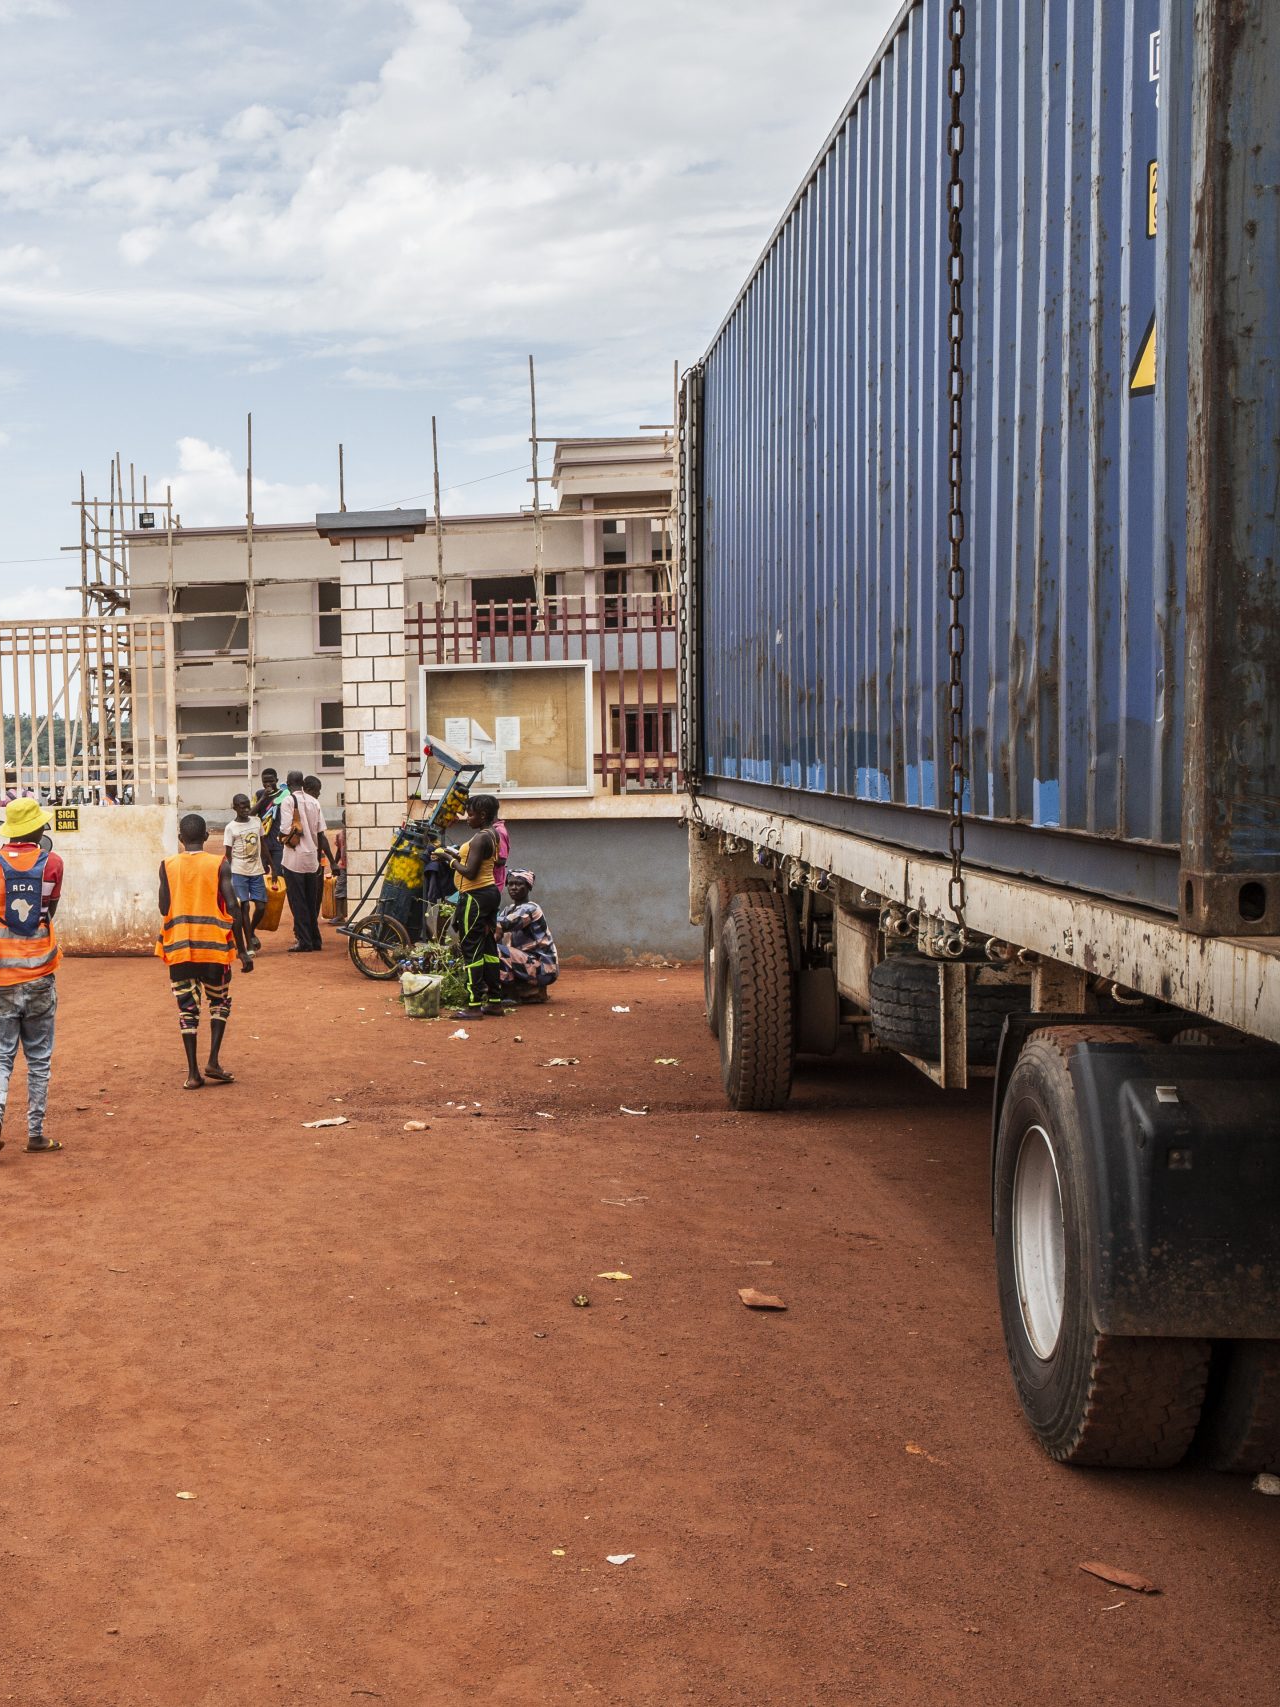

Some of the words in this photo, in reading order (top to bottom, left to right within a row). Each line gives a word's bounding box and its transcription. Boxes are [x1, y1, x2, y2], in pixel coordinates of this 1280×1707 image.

[57, 810, 76, 819] SICA
[57, 821, 76, 830] SARL
[12, 884, 34, 892] RCA
